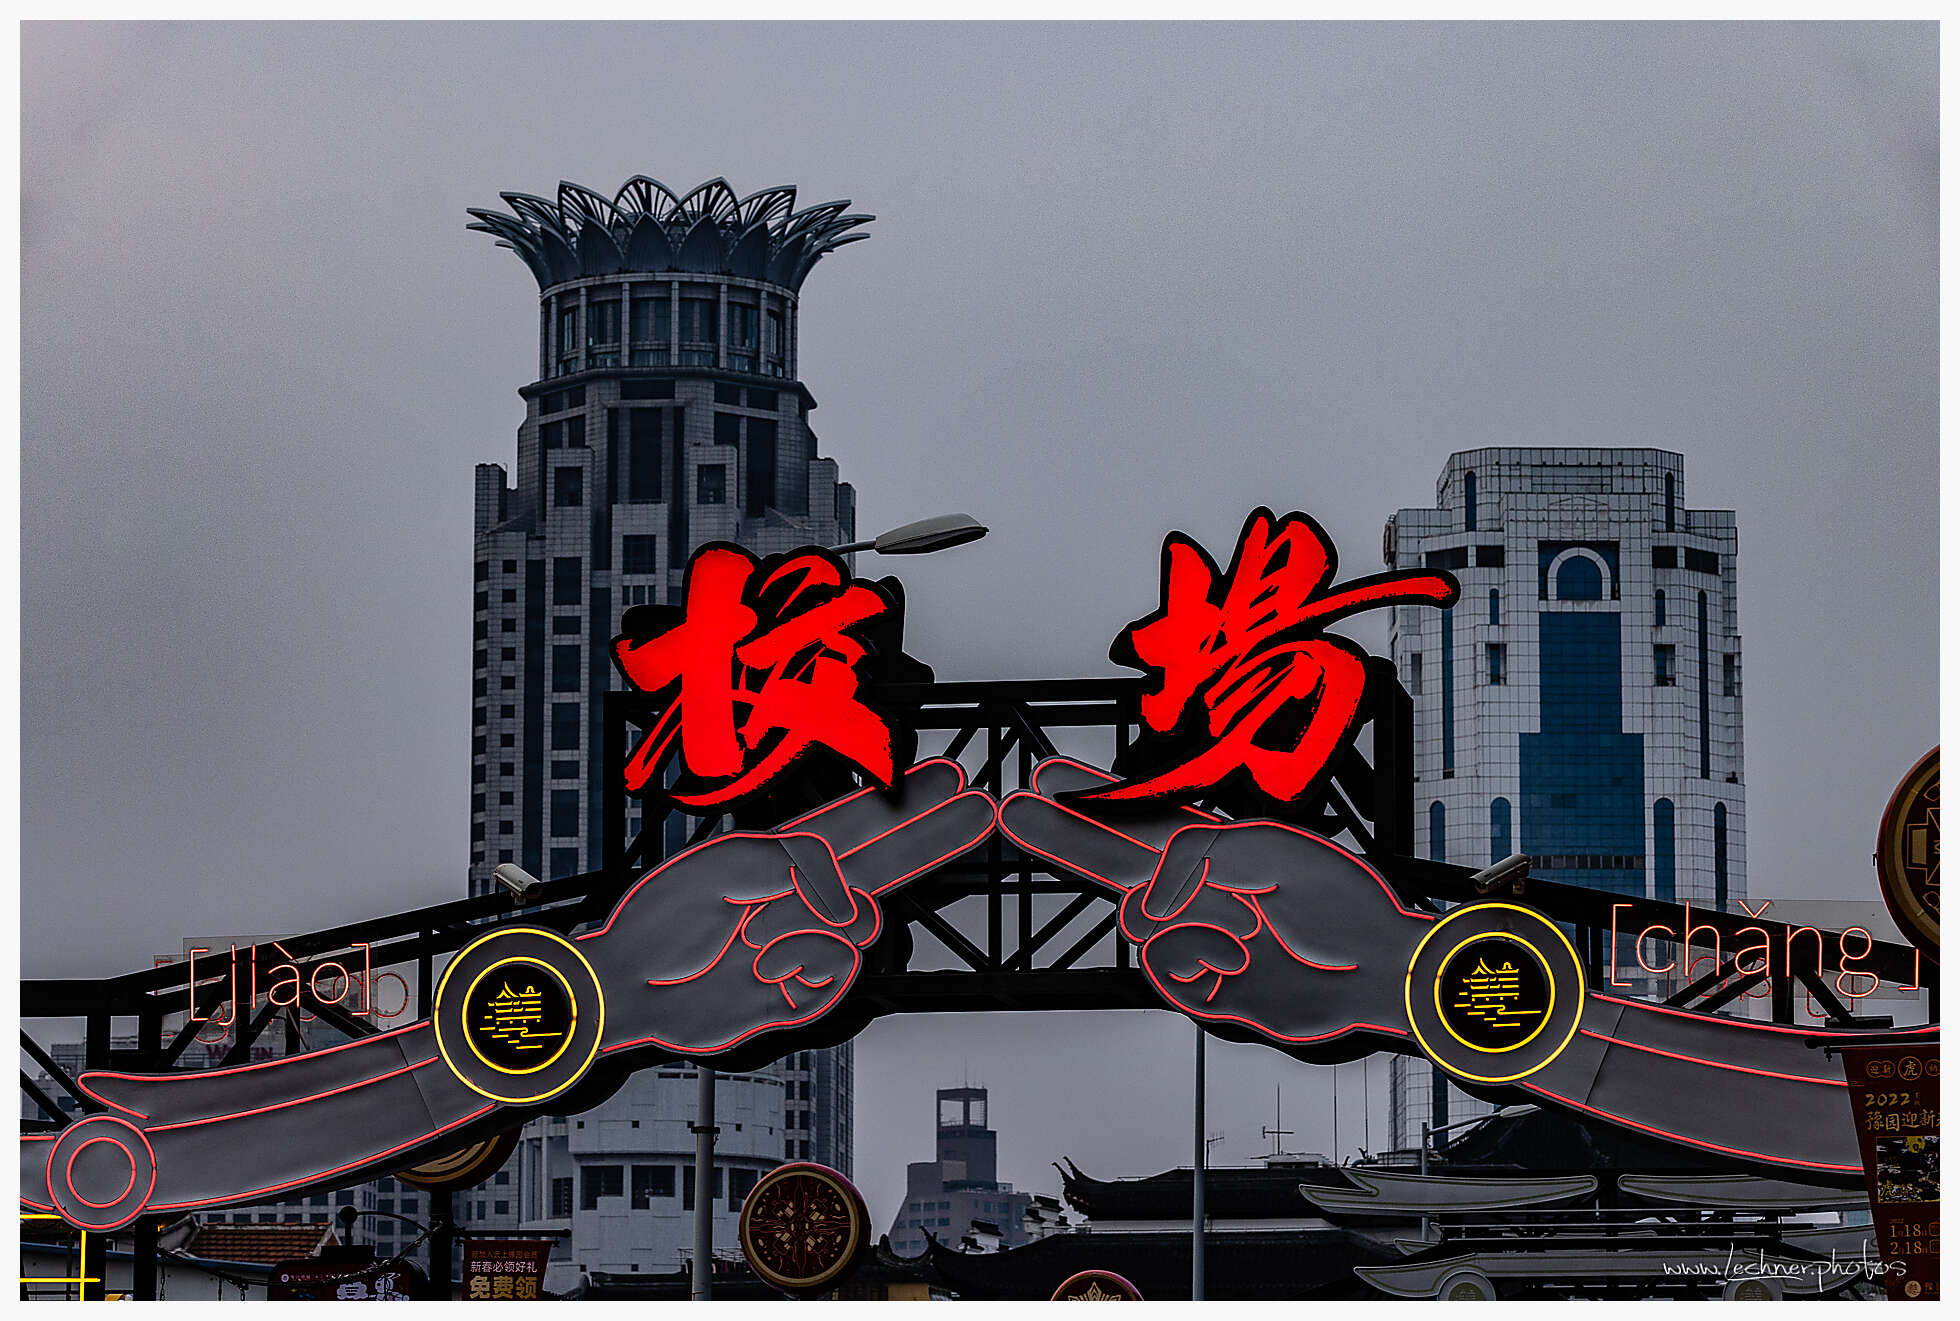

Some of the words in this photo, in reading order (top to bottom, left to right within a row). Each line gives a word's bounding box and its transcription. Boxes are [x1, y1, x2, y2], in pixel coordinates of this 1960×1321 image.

[1865, 1091, 1911, 1107] 2022
[1865, 1107, 1940, 1133] 豫园迎新
[470, 1260, 538, 1273] 新春必领好礼
[469, 1275, 538, 1300] 免费领
